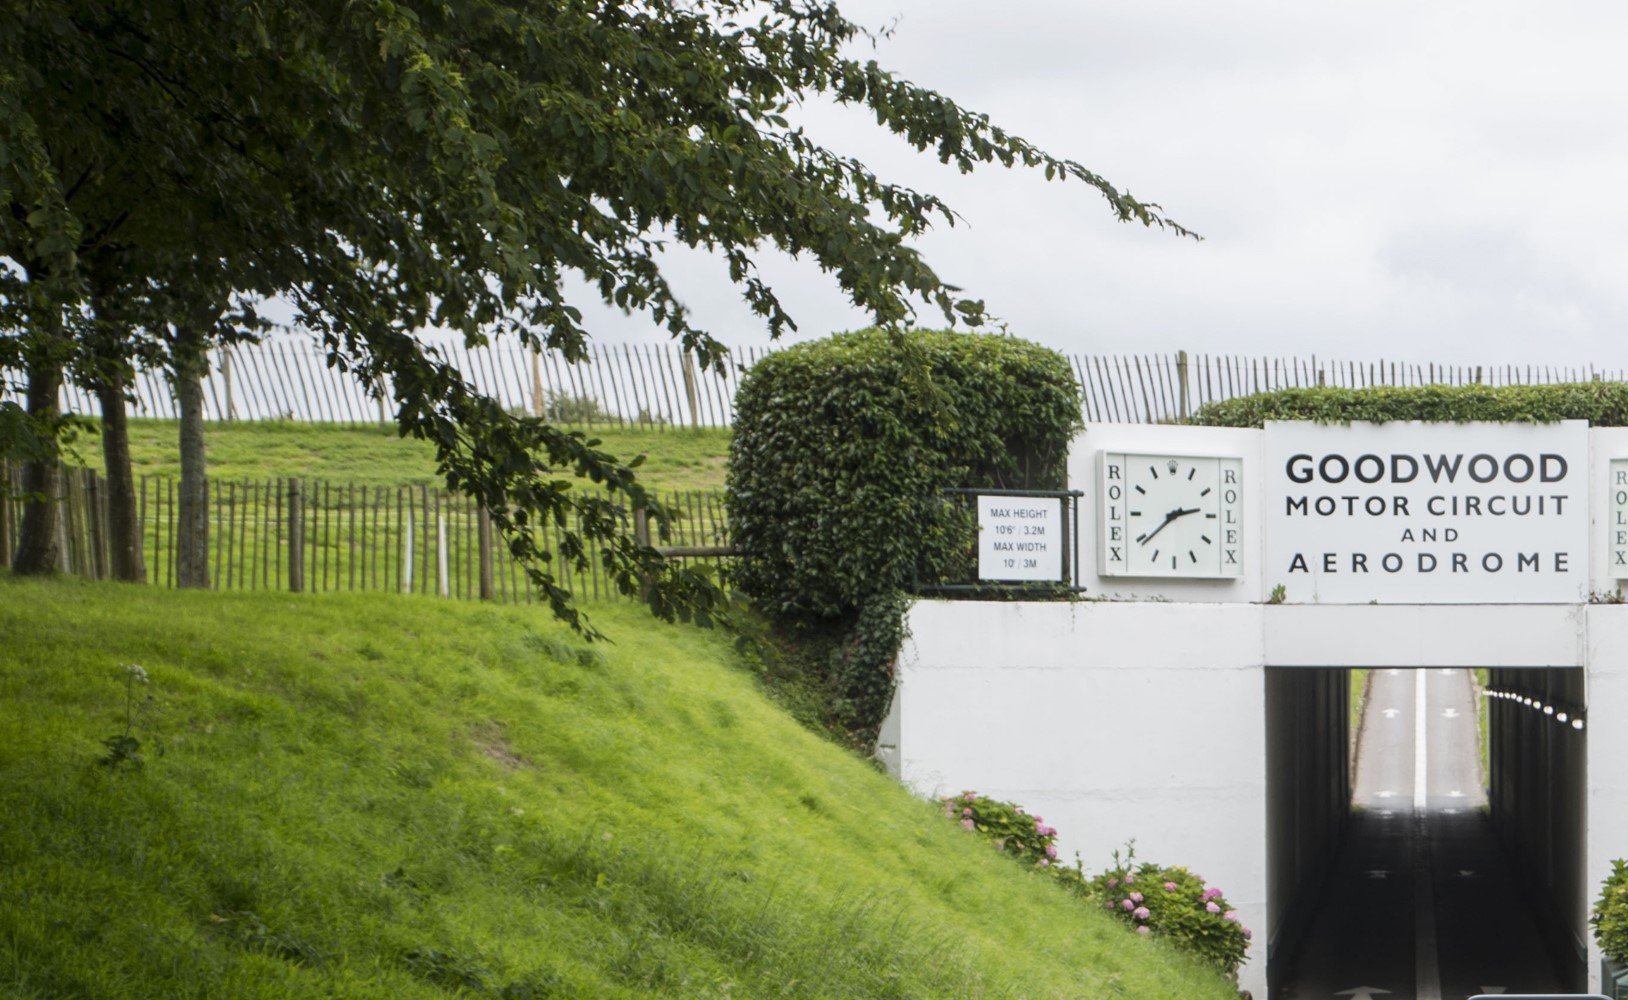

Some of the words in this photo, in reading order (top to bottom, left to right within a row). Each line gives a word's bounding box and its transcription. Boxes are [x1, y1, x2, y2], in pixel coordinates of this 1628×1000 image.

[1285, 453, 1569, 484] GOODWOOD
[990, 508, 1011, 518] MAX
[1013, 508, 1048, 519] HEIGHT
[1108, 464, 1123, 563] ROLEX
[1286, 495, 1410, 516] MOTOR
[1427, 495, 1569, 516] CIRCUIT
[1223, 468, 1238, 565] ROLEX
[1615, 470, 1628, 566] ROLEX
[1023, 526, 1045, 536] 3.2M
[1401, 528, 1459, 542] AND
[993, 542, 1014, 551] MAX
[1016, 542, 1047, 552] WIDTH
[1023, 559, 1037, 568] 3M
[1288, 552, 1569, 573] AERODROME
